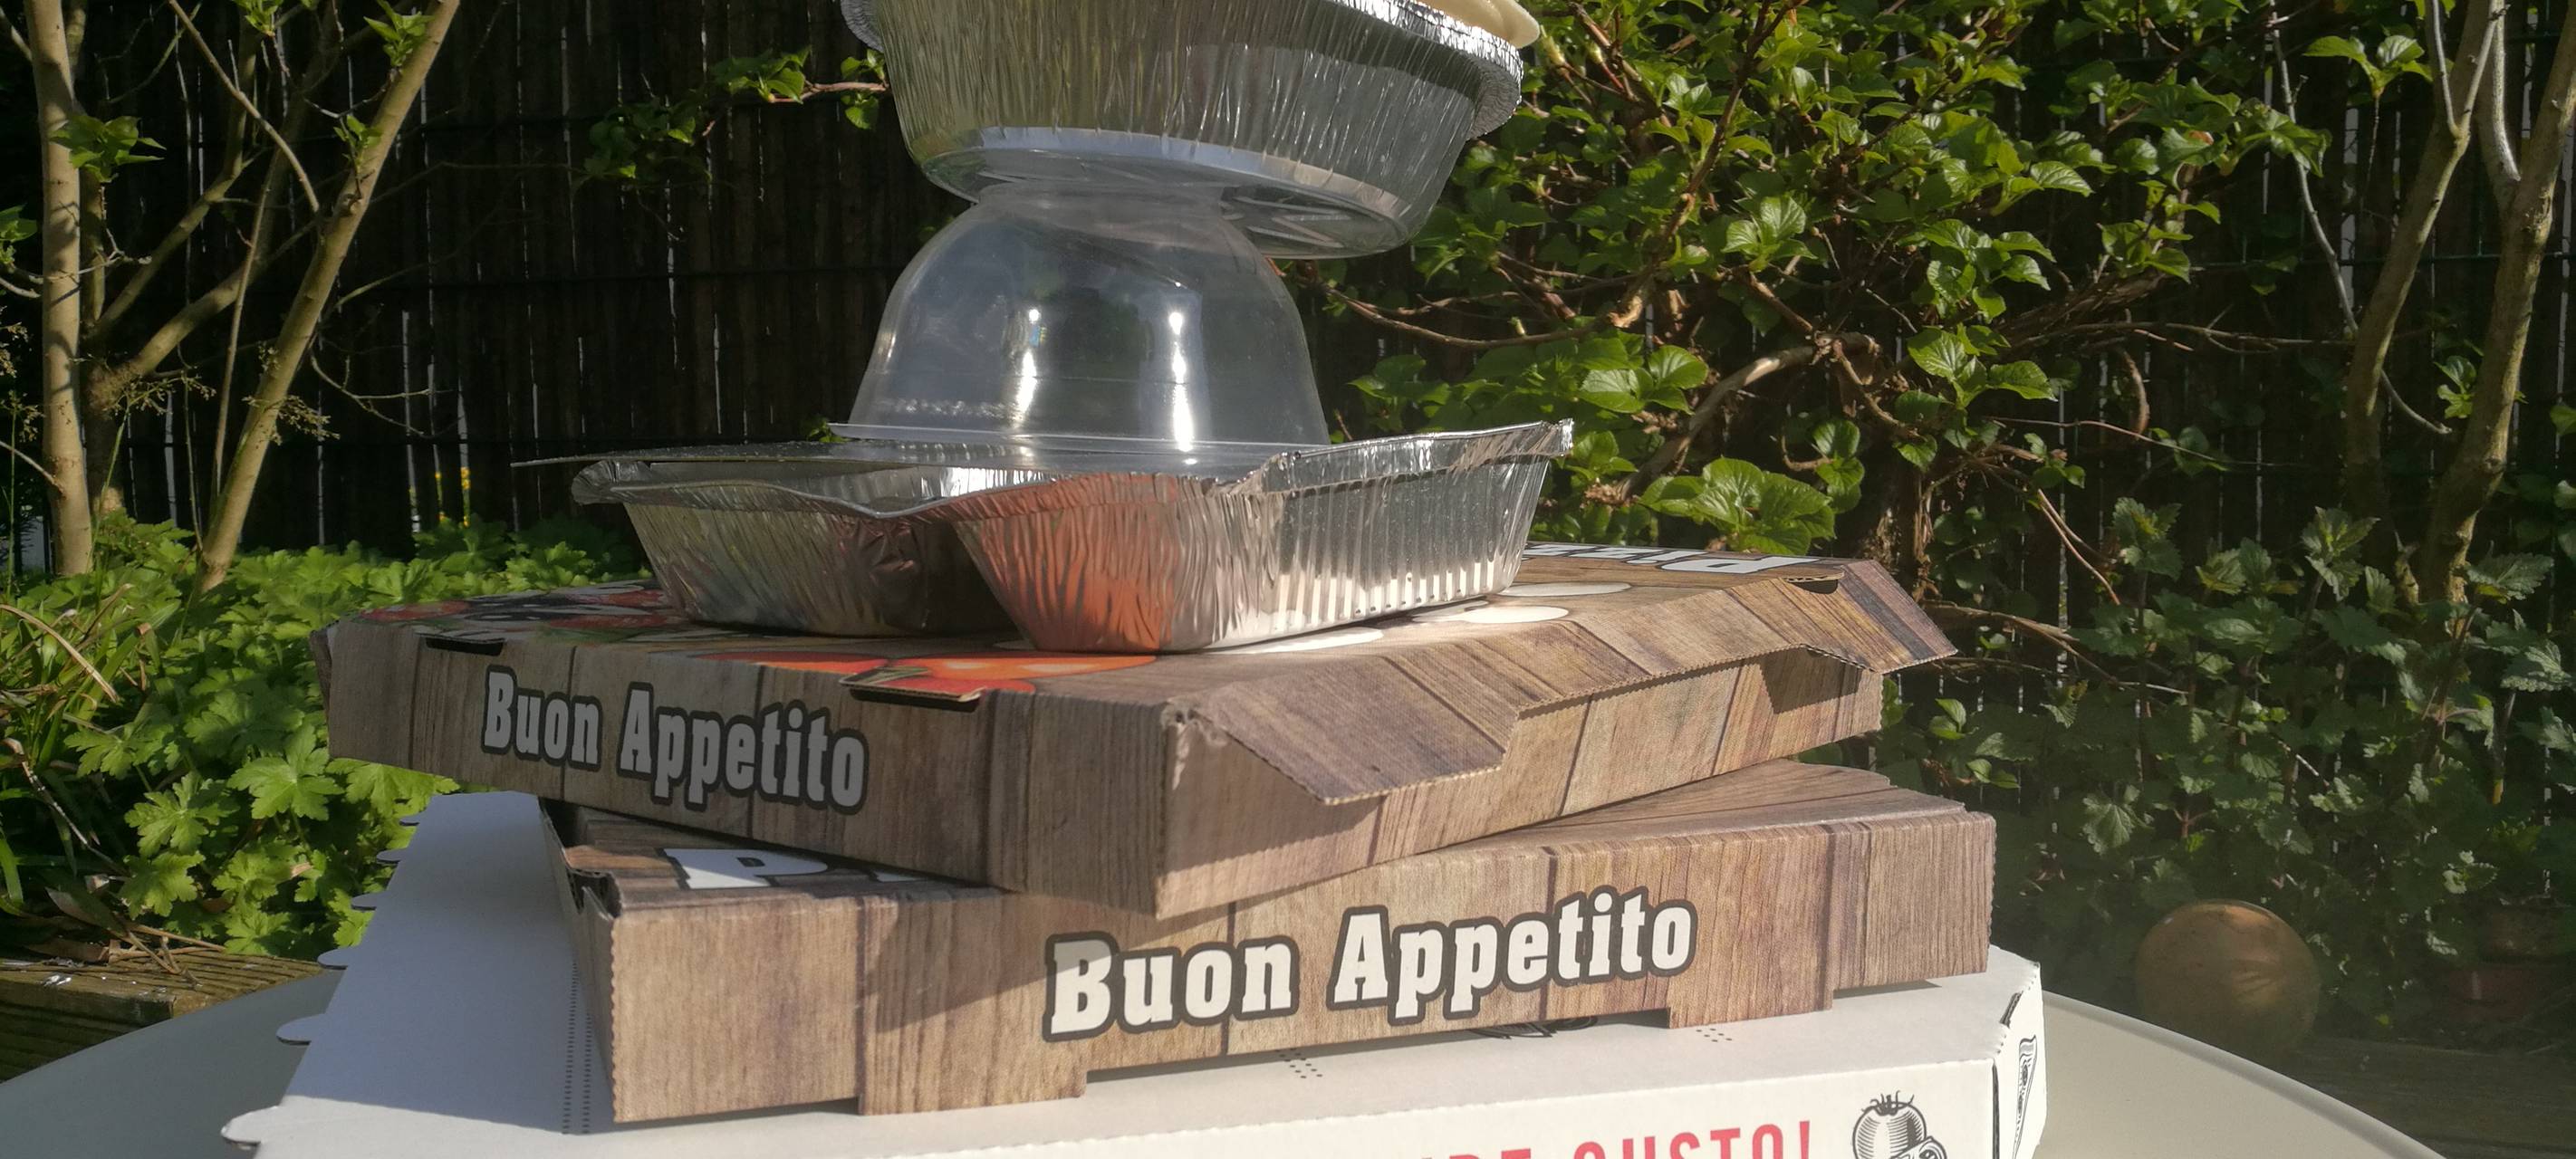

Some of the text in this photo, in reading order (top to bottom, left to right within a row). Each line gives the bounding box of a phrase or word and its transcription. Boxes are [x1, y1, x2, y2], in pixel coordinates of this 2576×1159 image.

[1523, 542, 1821, 575] Pizz
[482, 666, 868, 813] Buon Appetito
[1045, 886, 1697, 1039] Buon Appetito
